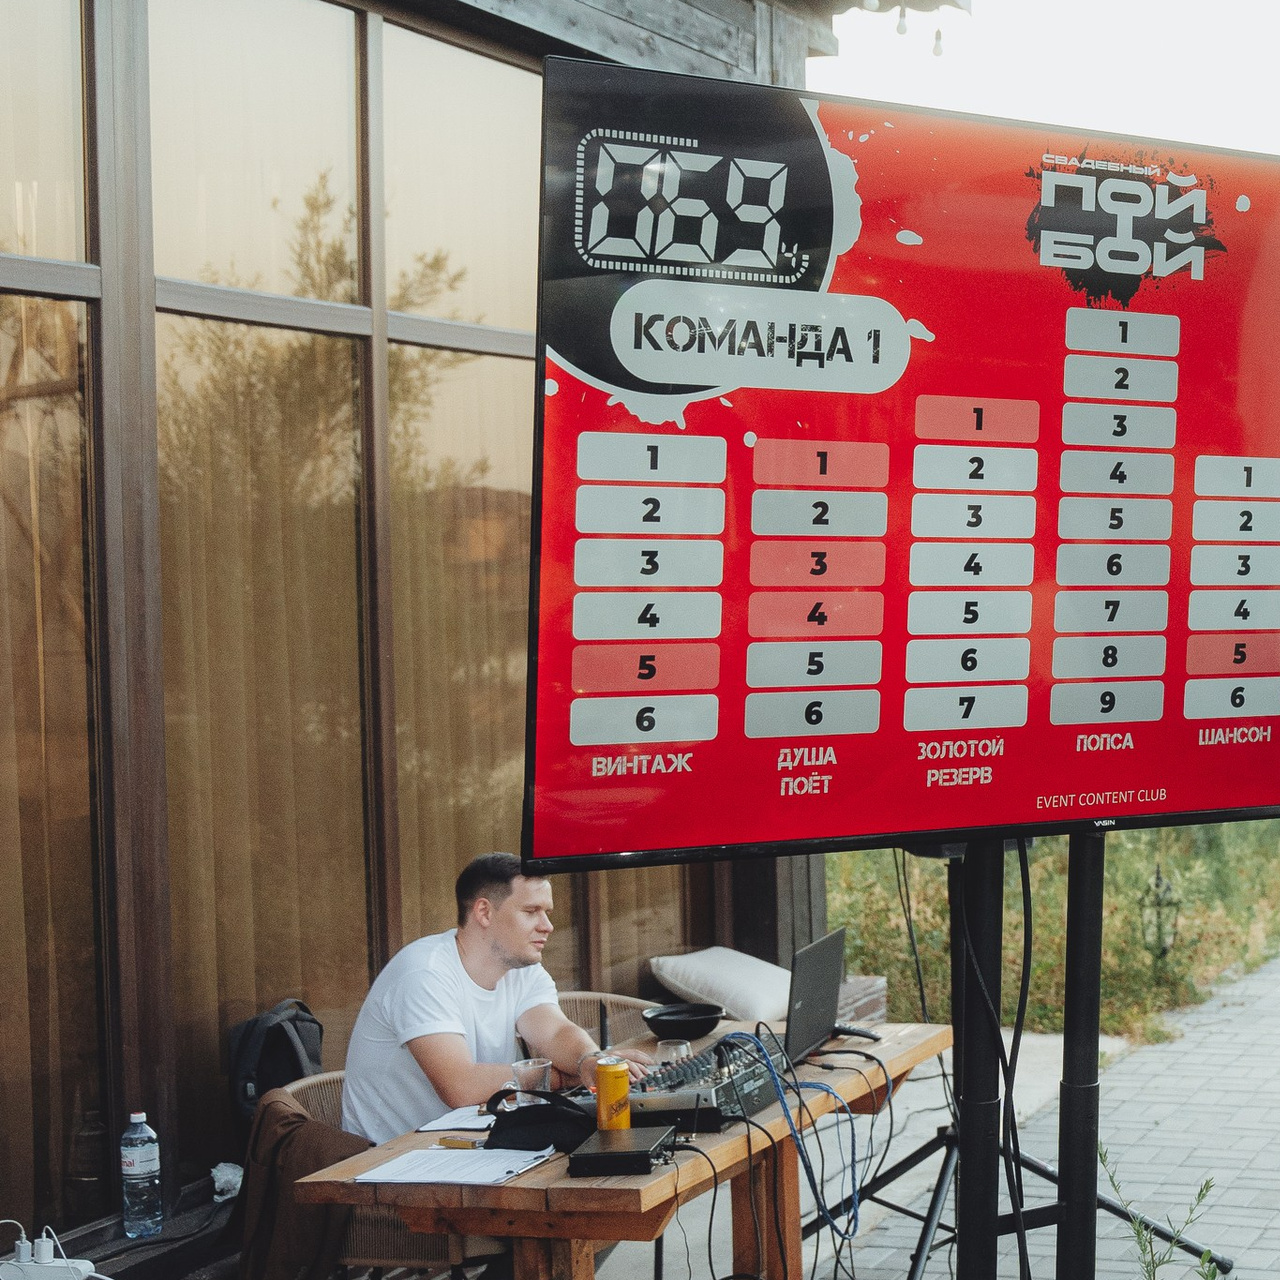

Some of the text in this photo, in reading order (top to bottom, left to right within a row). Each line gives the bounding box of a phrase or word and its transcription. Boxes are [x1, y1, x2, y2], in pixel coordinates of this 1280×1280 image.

[1042, 153, 1161, 177] СВАДЕБНЫЙ
[588, 143, 788, 269] 069
[1041, 170, 1207, 224] ПОЙ
[1040, 228, 1205, 281] БОЙ
[633, 312, 882, 369] КОМАНДА 1
[1118, 320, 1129, 344] 1
[1114, 367, 1130, 390] 2
[972, 407, 984, 431] 1
[1111, 414, 1128, 437] 3
[646, 445, 659, 471] 1
[816, 451, 828, 476] 1
[968, 456, 985, 480] 2
[1109, 461, 1127, 484] 4
[1243, 466, 1253, 488] 1
[641, 497, 661, 523] 2
[811, 500, 829, 526] 2
[966, 504, 983, 528] 3
[1108, 507, 1124, 530] 5
[1239, 510, 1253, 532] 2
[639, 550, 660, 576] 3
[809, 551, 828, 576] 3
[963, 552, 983, 576] 4
[1106, 553, 1123, 576] 6
[1236, 554, 1251, 576] 3
[637, 603, 660, 628] 4
[806, 602, 828, 626] 4
[962, 601, 979, 625] 5
[1104, 600, 1121, 622] 7
[1233, 599, 1251, 621] 4
[806, 651, 825, 676] 5
[960, 647, 978, 672] 6
[1101, 645, 1118, 668] 8
[1232, 642, 1247, 665] 5
[637, 654, 657, 680] 5
[958, 696, 976, 720] 7
[1099, 690, 1116, 714] 9
[1230, 686, 1246, 708] 6
[635, 706, 656, 732] 6
[804, 700, 823, 726] 6
[1076, 732, 1135, 752] ПОПСА
[1198, 725, 1272, 746] ШАНСОН
[777, 746, 838, 771] ДУША
[917, 736, 1005, 761] ЗОЛОТОЙ
[591, 748, 694, 777] ВИНТАЖ
[780, 775, 833, 796] ПОЁТ
[926, 766, 993, 788] РЕЗЕРВ
[1036, 788, 1167, 809] EVENT CONTENT CLUB
